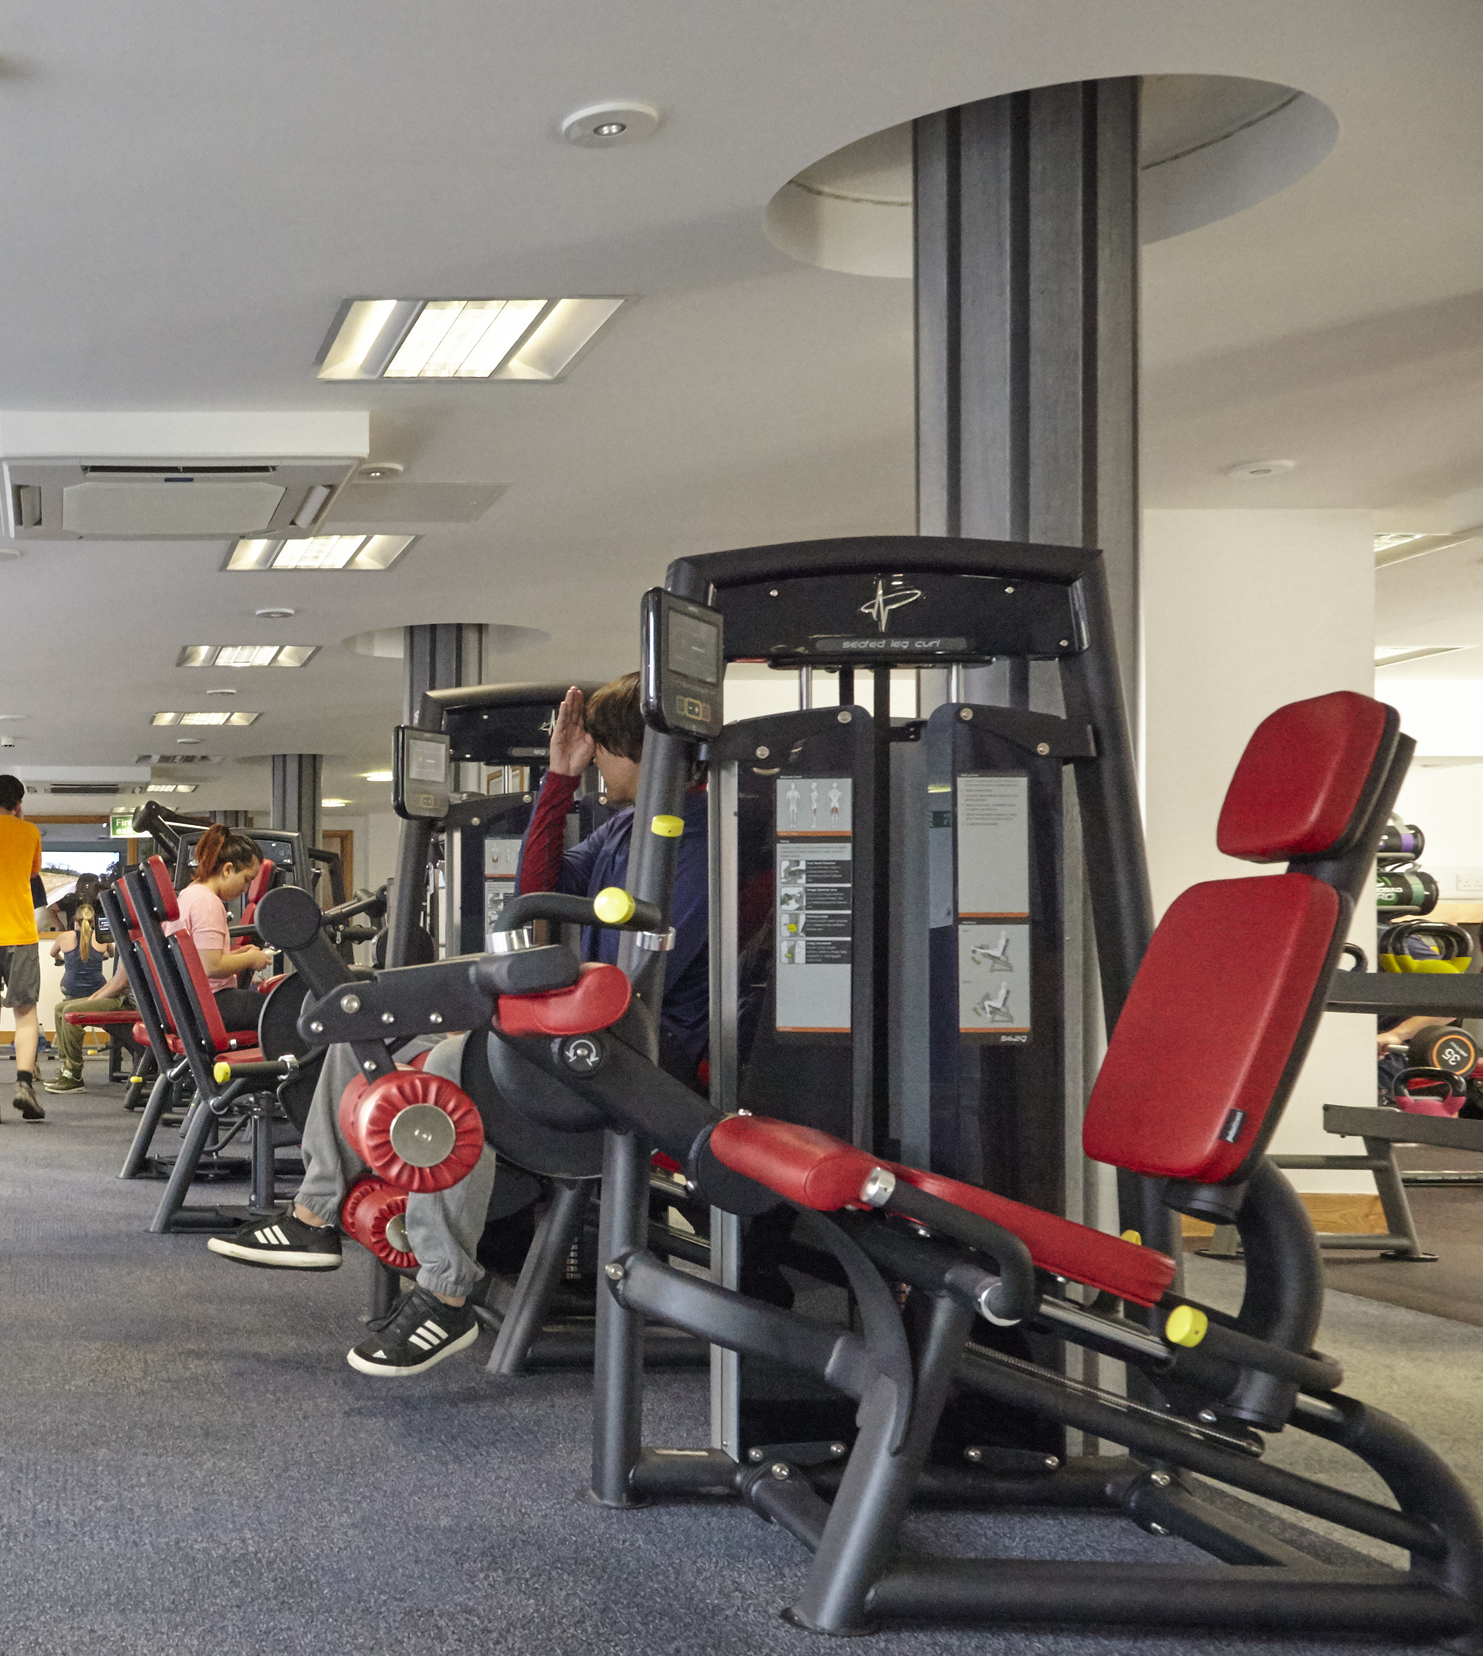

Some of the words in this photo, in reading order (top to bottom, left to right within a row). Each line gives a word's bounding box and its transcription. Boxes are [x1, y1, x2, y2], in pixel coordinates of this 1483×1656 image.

[842, 639, 886, 649] seated
[890, 639, 909, 649] leg
[915, 639, 941, 648] curl
[116, 827, 133, 835] exit
[1441, 1048, 1461, 1066] 35
